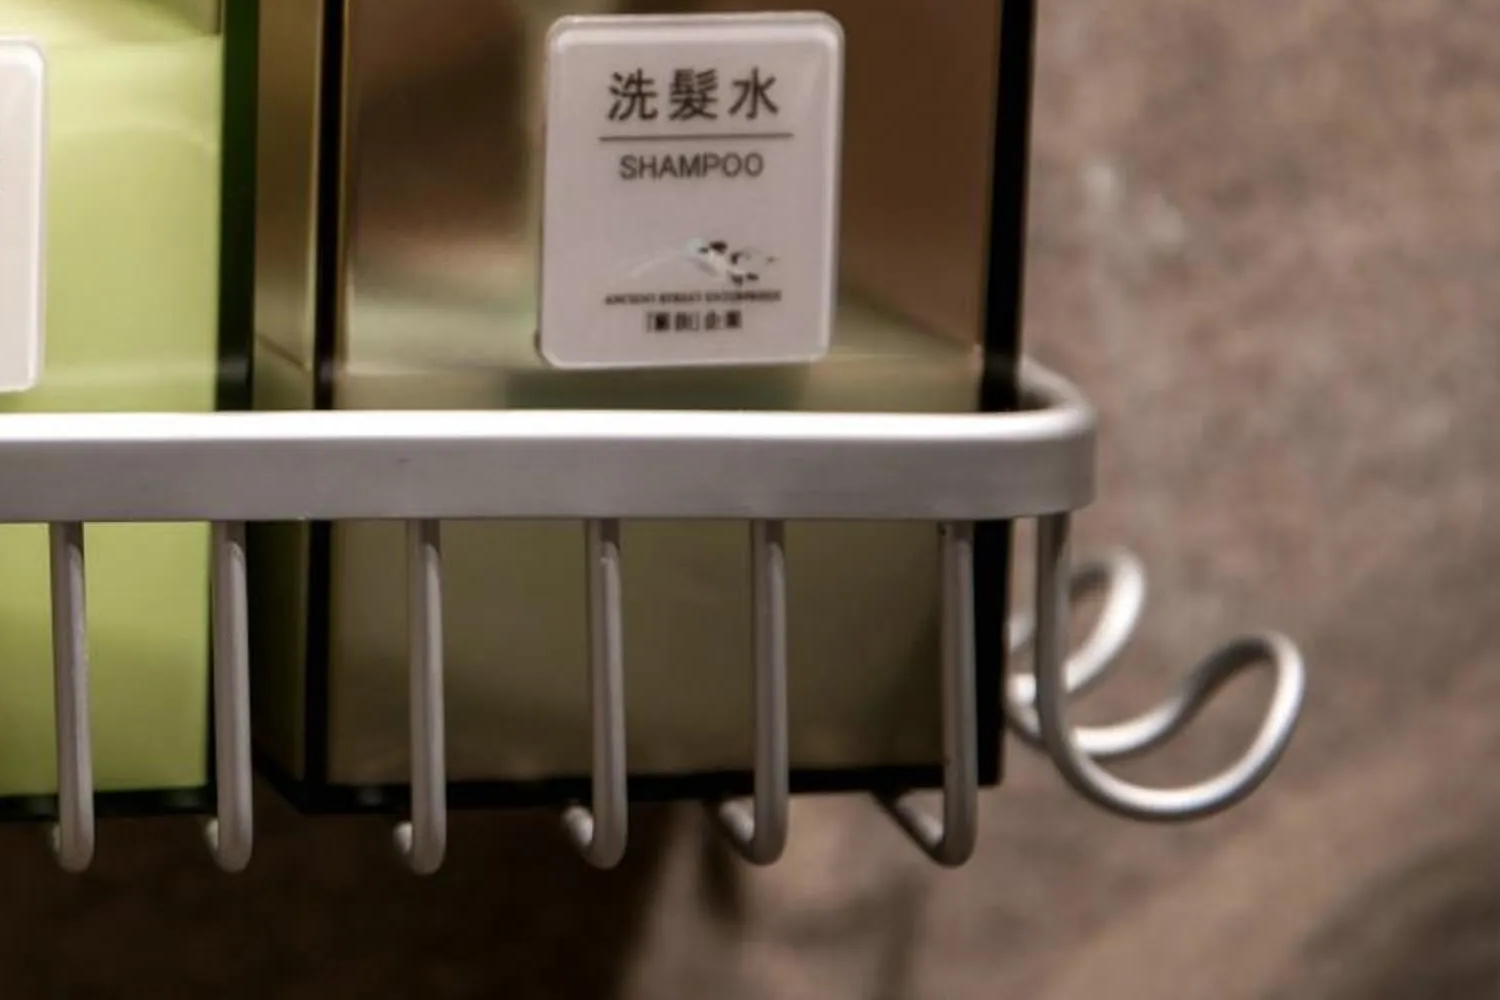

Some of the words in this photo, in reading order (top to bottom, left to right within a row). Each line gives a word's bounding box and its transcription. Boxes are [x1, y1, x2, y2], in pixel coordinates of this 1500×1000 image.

[606, 67, 779, 121] 洗髮水
[619, 152, 765, 180] SHAMPOO
